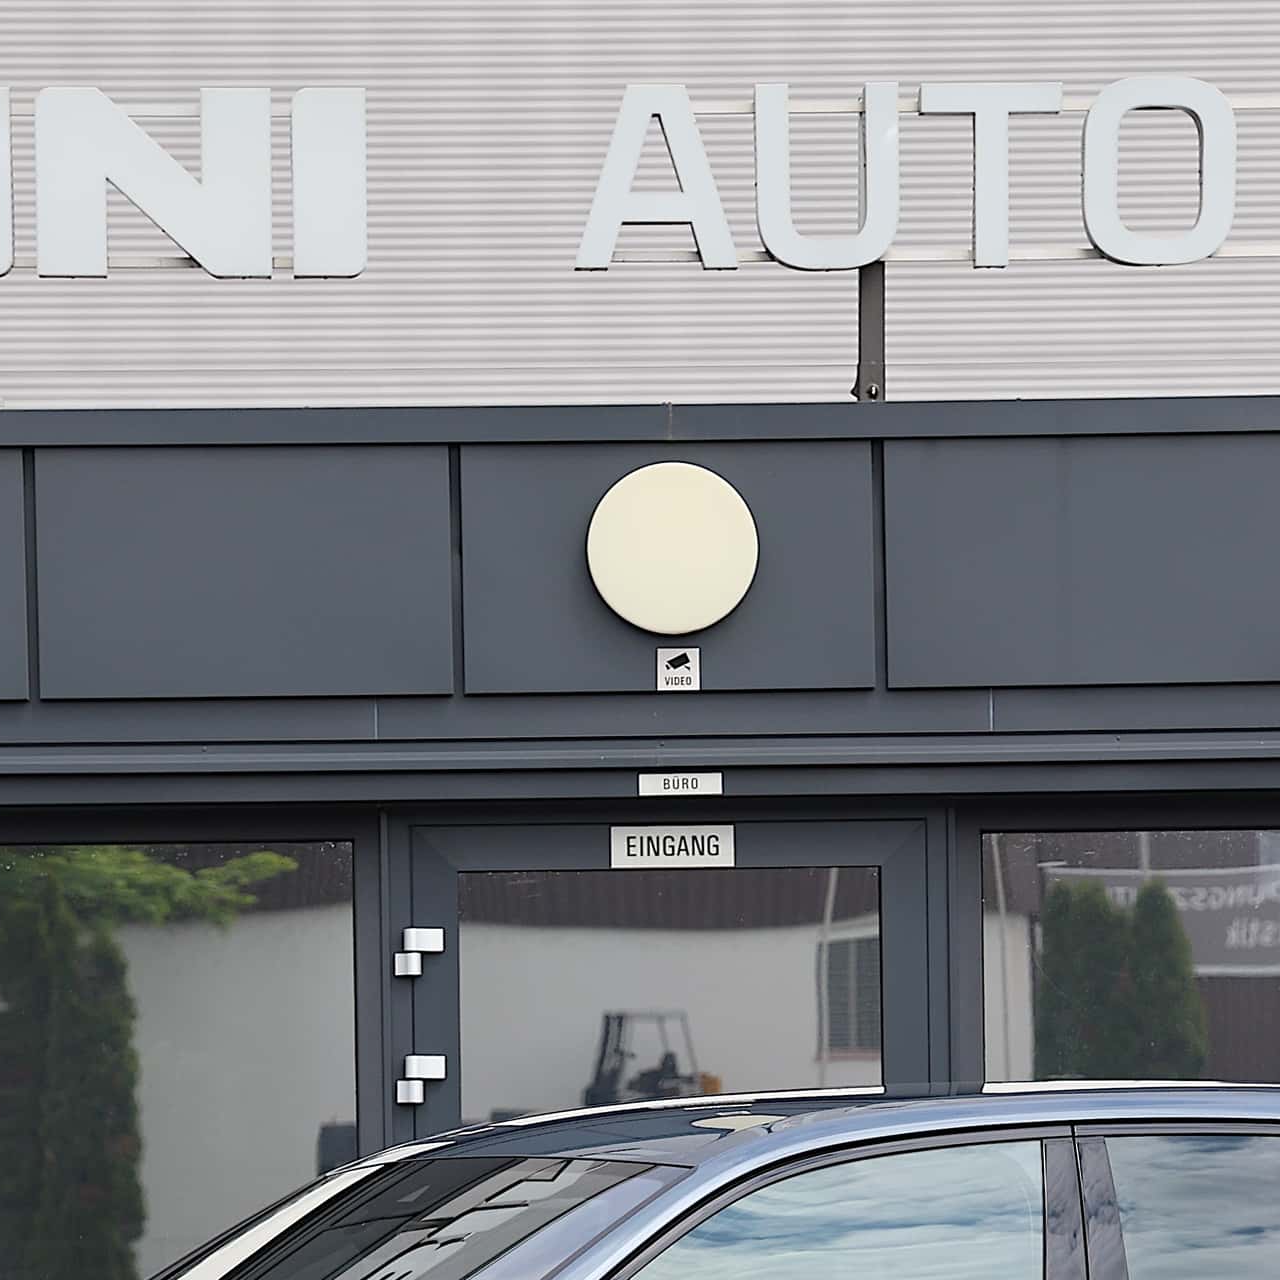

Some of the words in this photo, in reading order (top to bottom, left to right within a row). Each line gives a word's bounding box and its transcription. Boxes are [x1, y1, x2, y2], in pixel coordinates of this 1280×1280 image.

[574, 74, 1237, 272] AUTO
[664, 676, 693, 686] VIDEO
[662, 776, 699, 790] BÜRO
[625, 834, 720, 857] EINGANG
